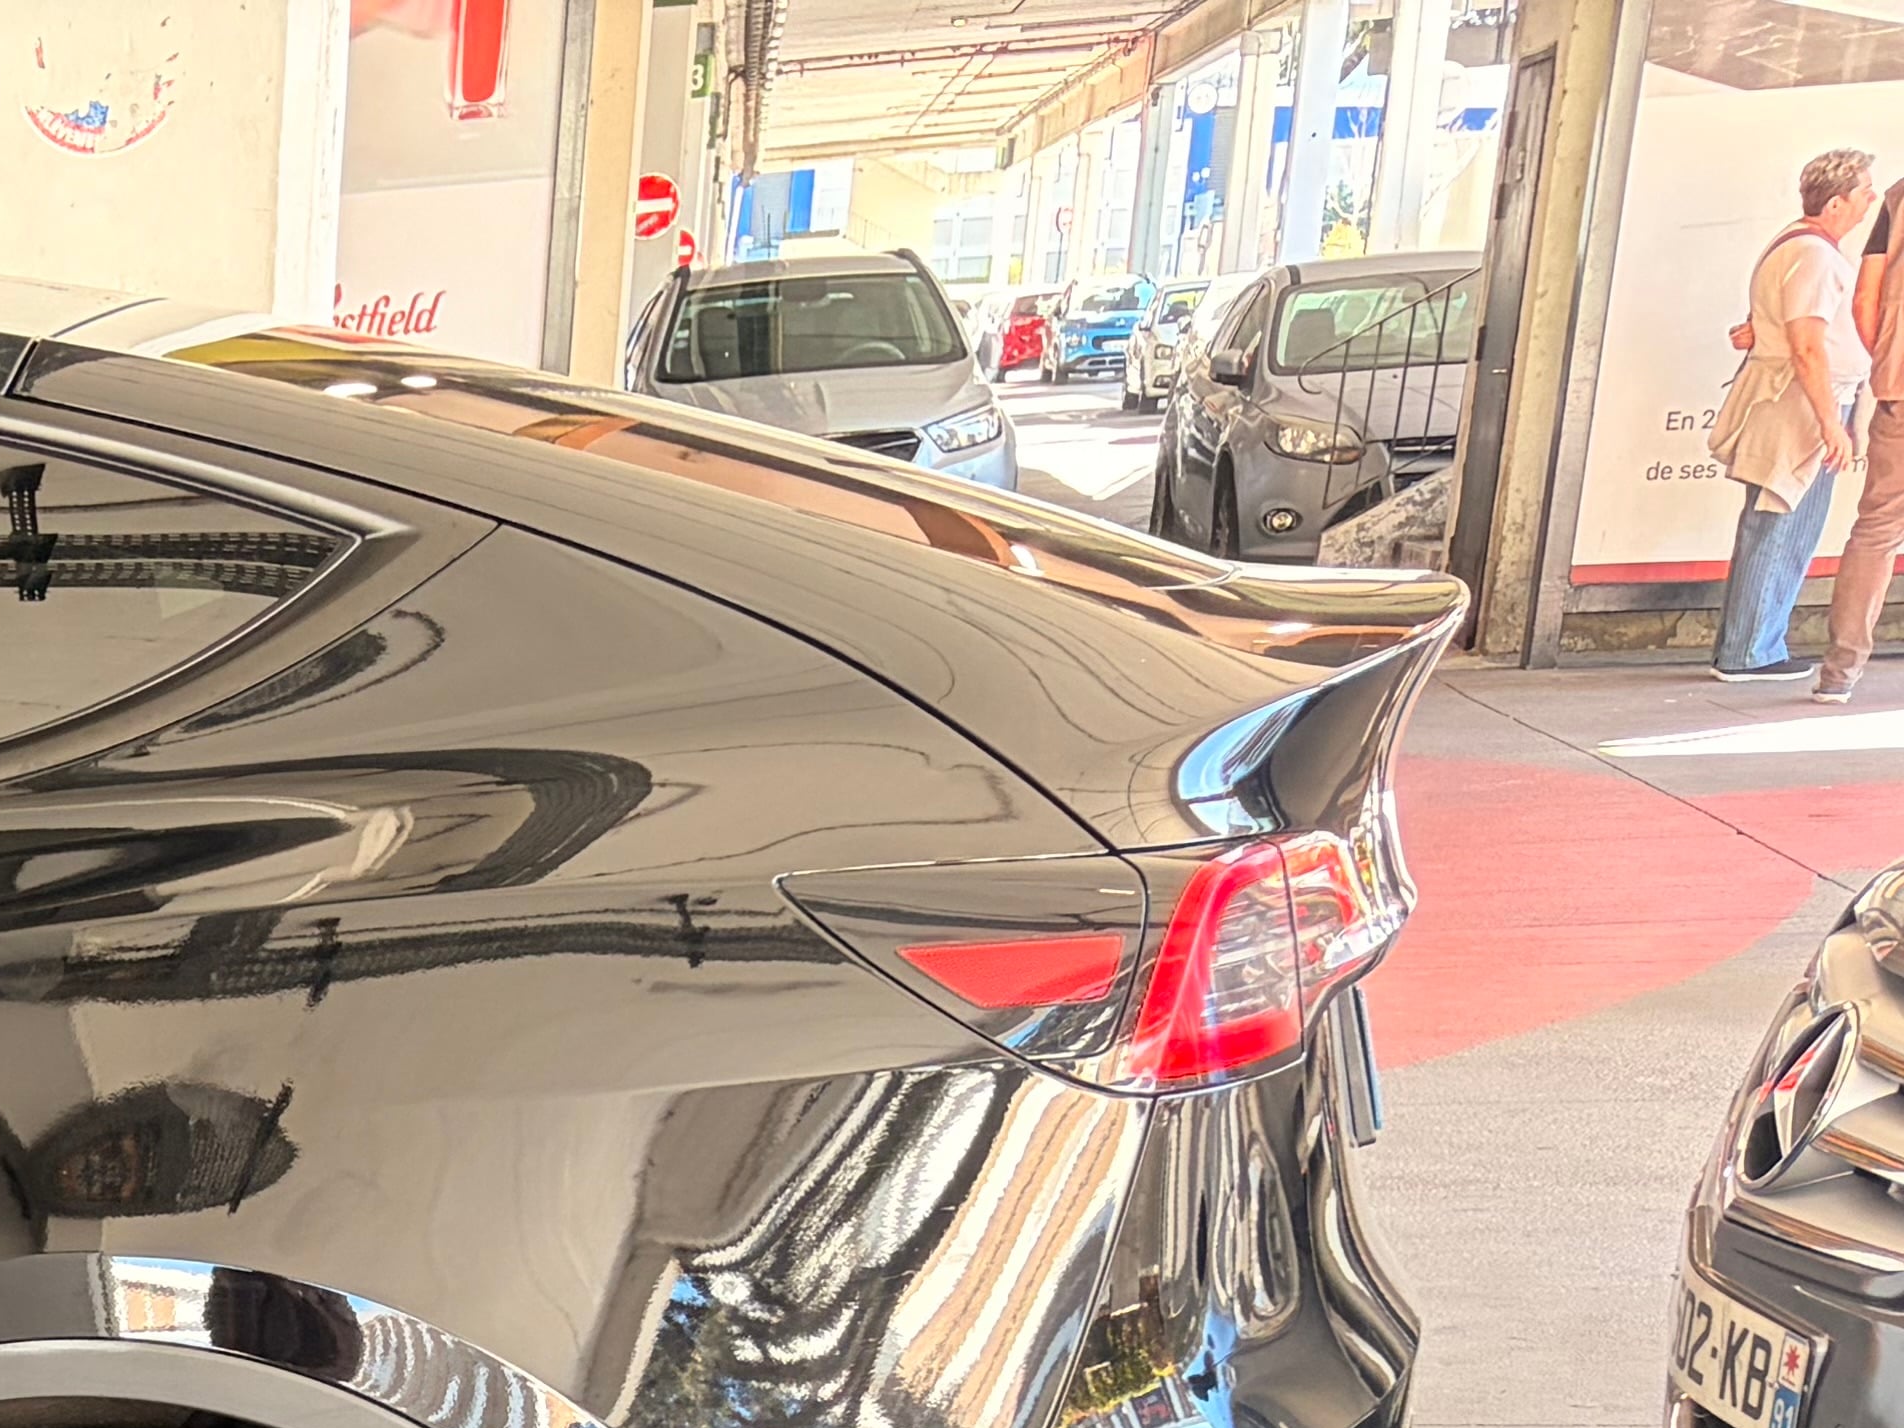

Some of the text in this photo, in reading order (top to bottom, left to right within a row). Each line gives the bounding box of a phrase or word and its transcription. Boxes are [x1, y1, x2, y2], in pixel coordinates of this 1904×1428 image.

[333, 283, 446, 336] stfield
[1665, 409, 1720, 431] En 2
[1645, 460, 1718, 481] de ses
[1674, 1284, 1773, 1422] 02-KB
